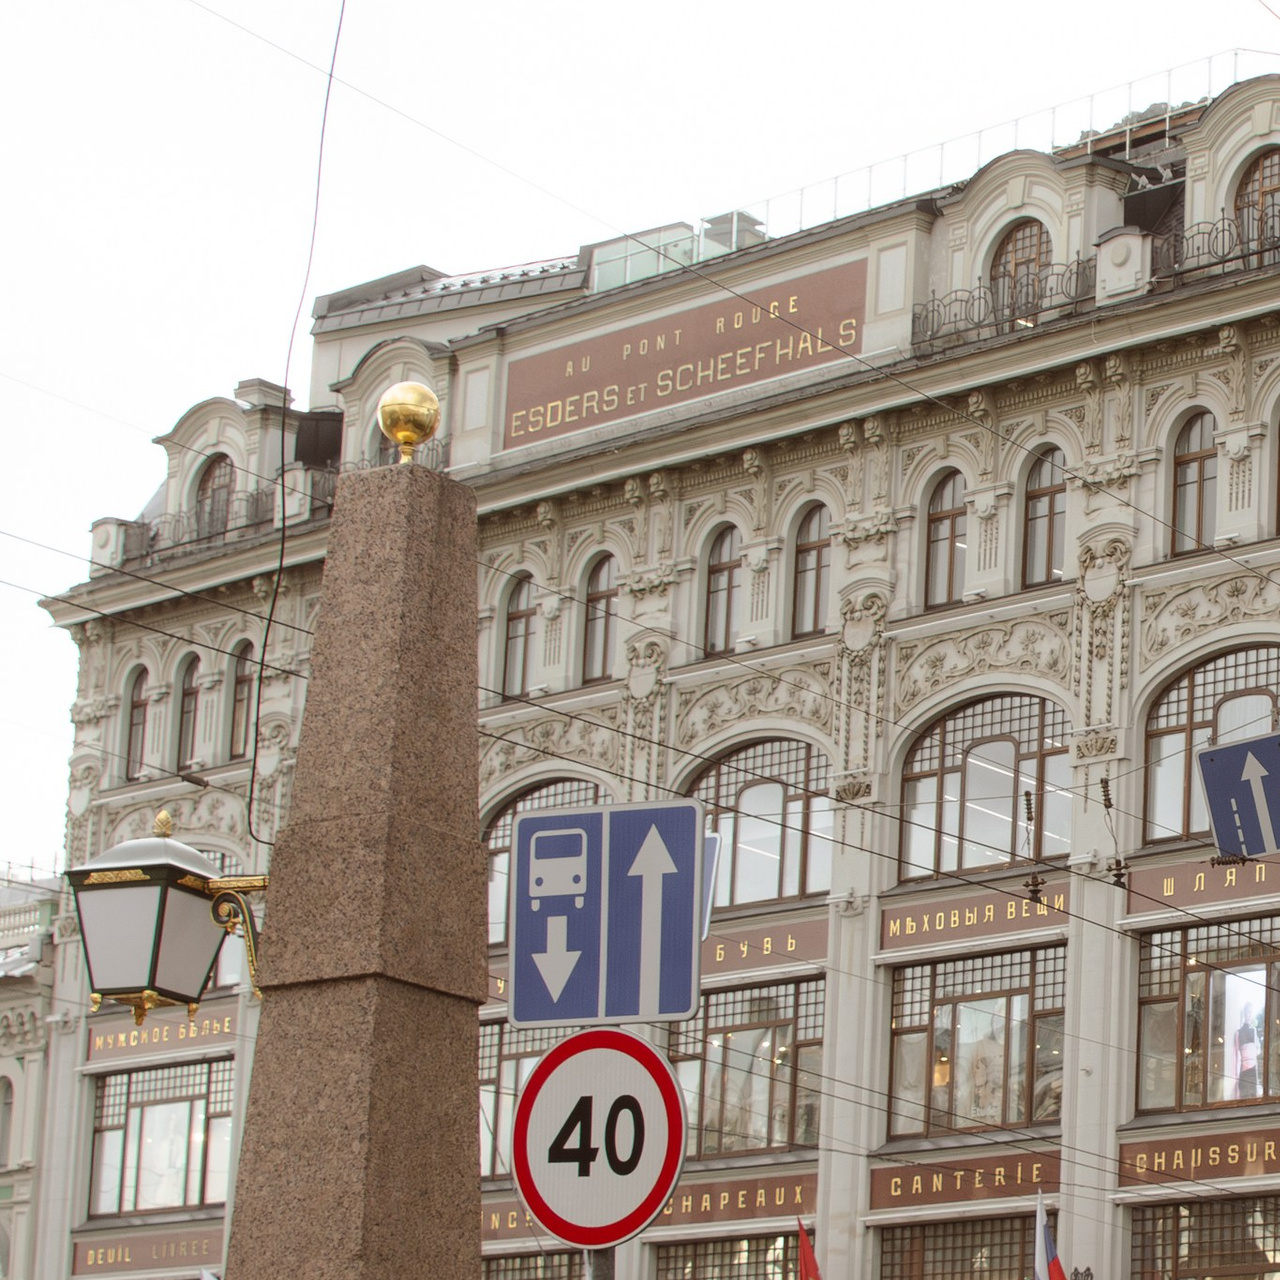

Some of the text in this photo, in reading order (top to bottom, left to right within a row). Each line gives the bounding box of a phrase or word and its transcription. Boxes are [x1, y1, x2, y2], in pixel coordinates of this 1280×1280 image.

[565, 296, 799, 377] AU PONT ROUGE
[510, 318, 857, 438] ESDERS ET SCHEEFHALS
[1007, 893, 1065, 920] ВЕЩИ
[716, 934, 797, 963] БУВЬ
[548, 1094, 645, 1178] 40
